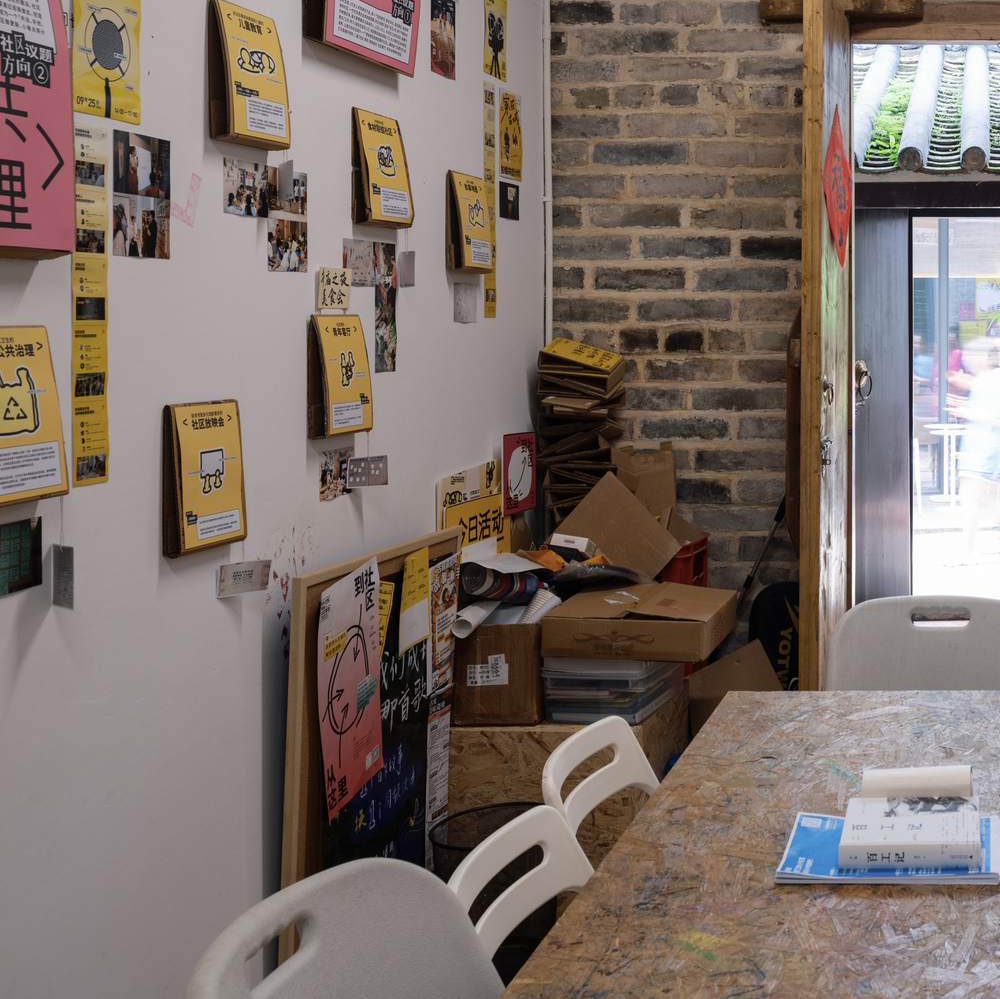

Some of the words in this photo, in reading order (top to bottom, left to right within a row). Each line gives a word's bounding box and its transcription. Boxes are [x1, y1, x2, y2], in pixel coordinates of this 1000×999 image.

[238, 18, 263, 36] 儿童教育
[0, 33, 53, 63] 社区议题
[830, 153, 848, 212] 福
[191, 417, 225, 430] 社区放映会
[458, 505, 505, 545] 今日活动
[365, 566, 375, 612] 社区
[380, 675, 428, 733] 那首歌
[327, 775, 349, 811] 这里
[866, 851, 905, 863] 百工记
